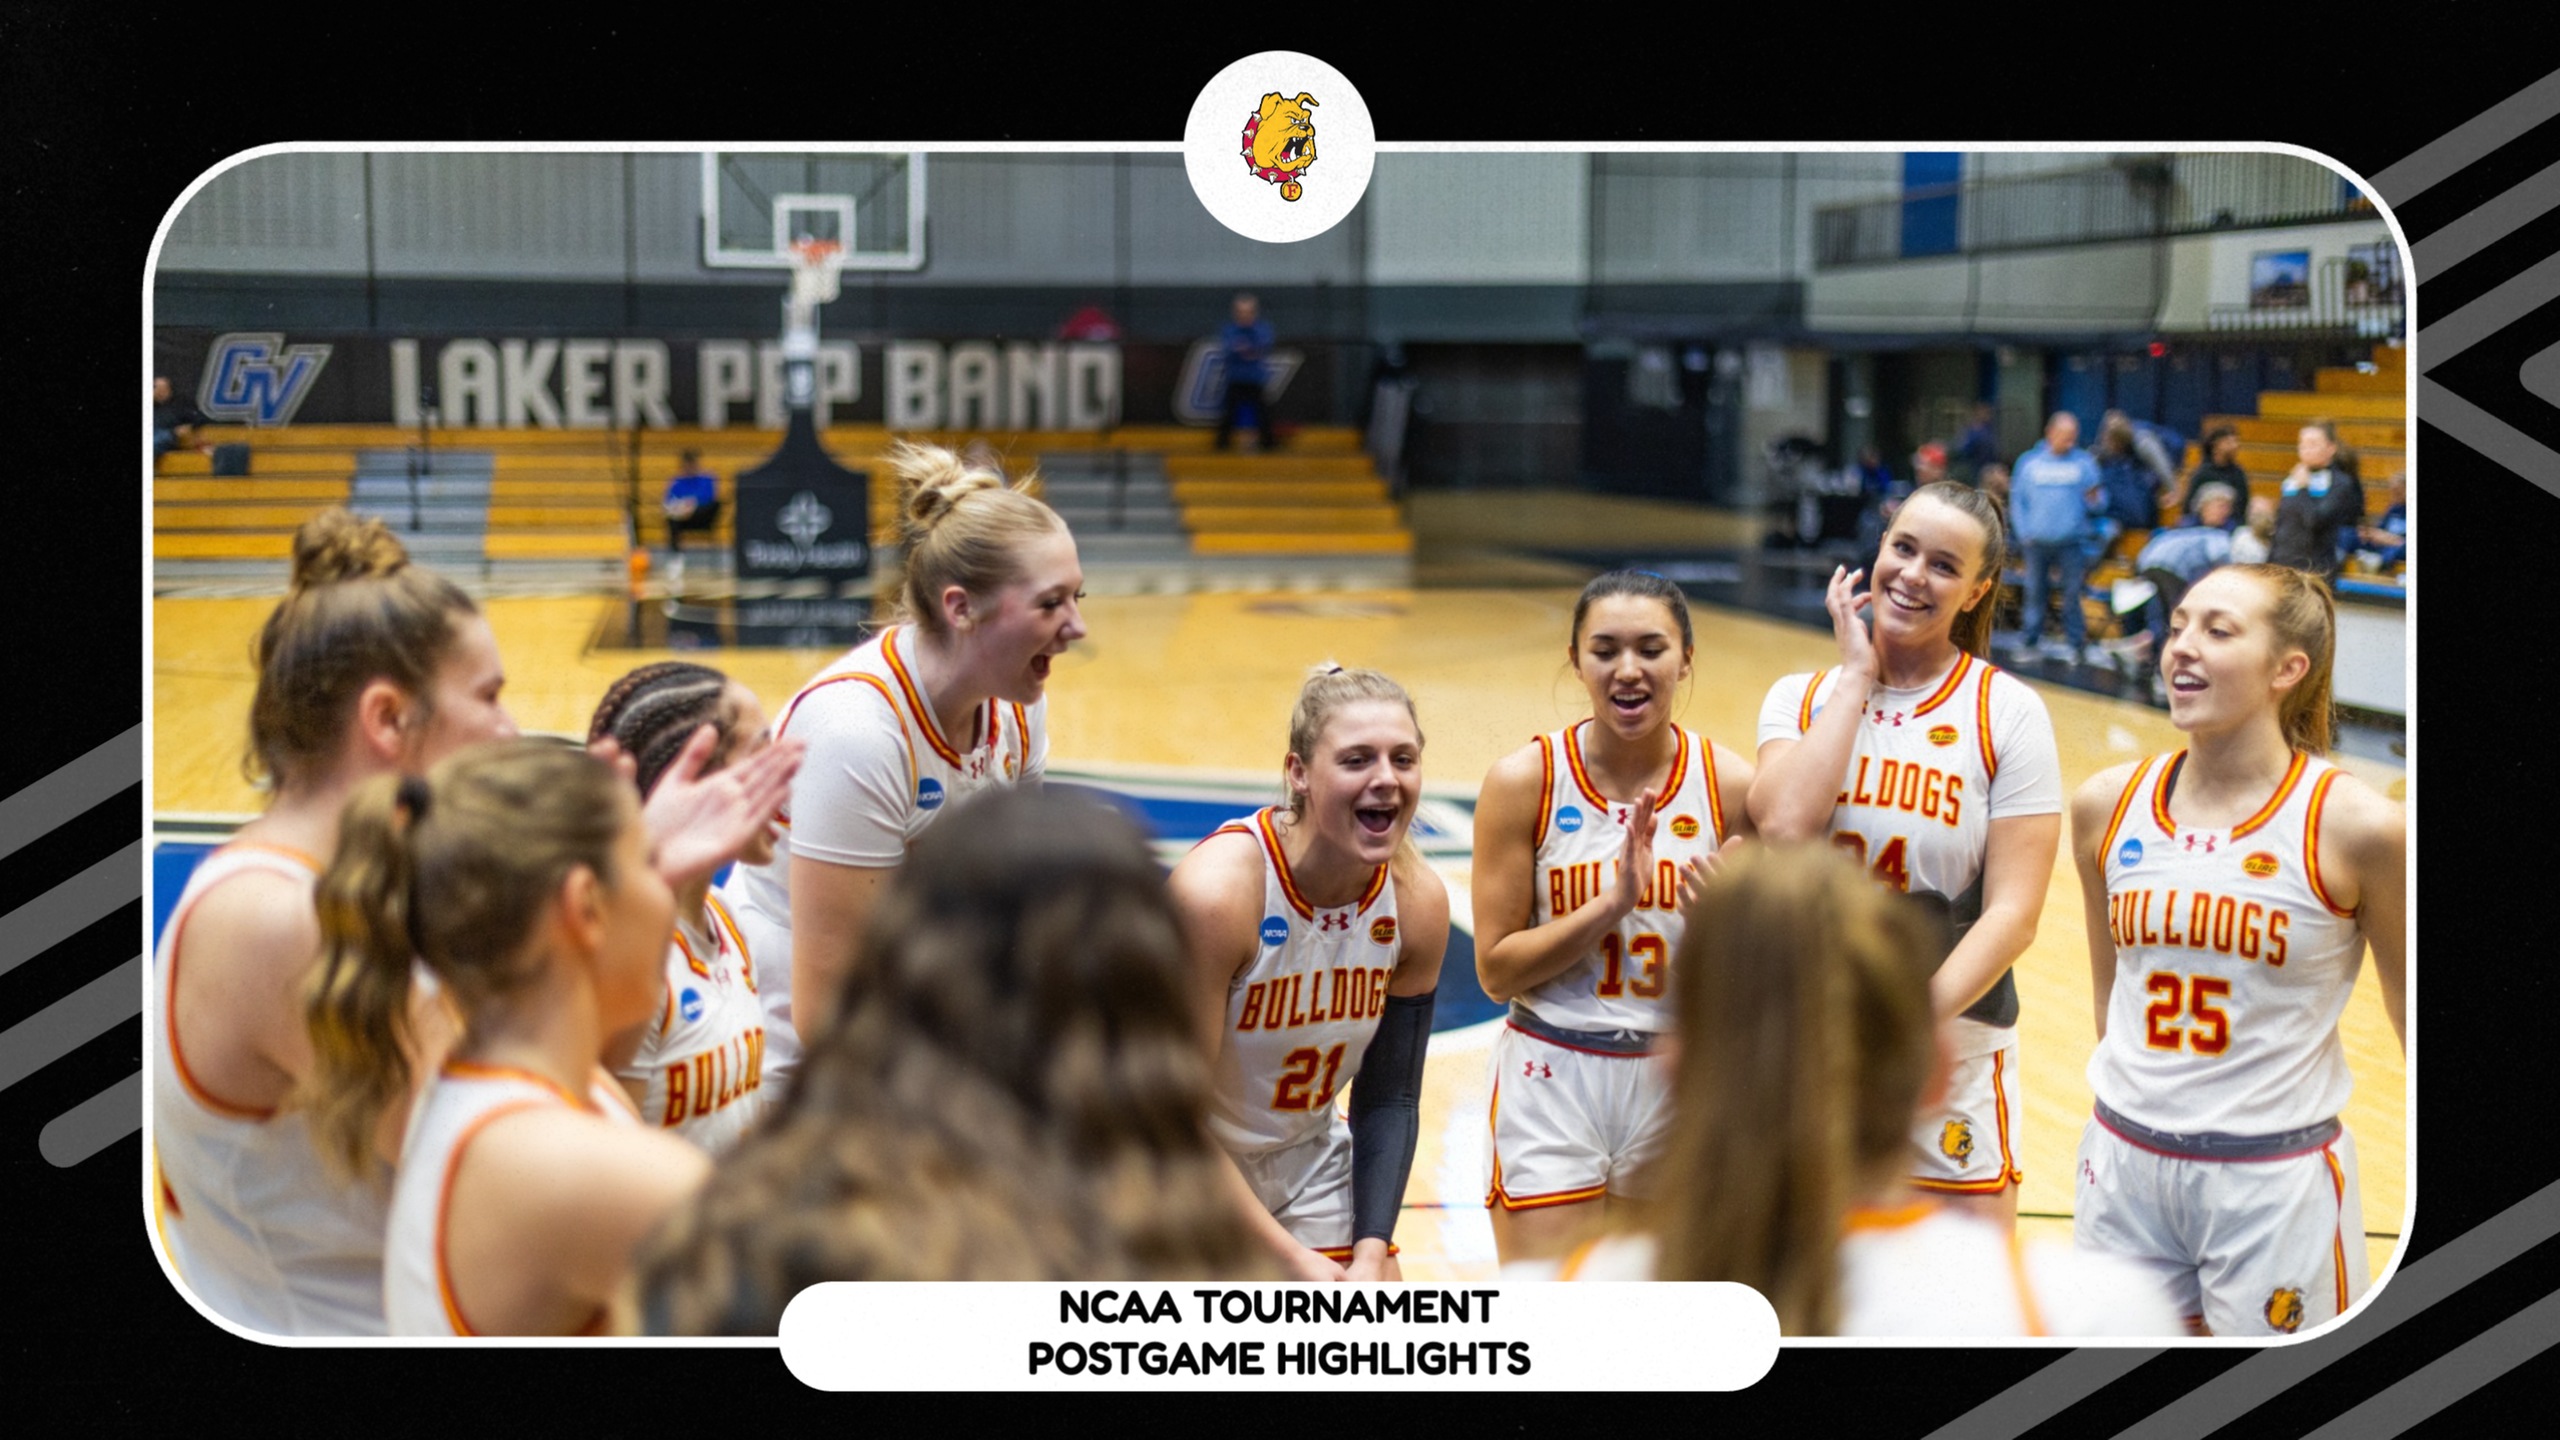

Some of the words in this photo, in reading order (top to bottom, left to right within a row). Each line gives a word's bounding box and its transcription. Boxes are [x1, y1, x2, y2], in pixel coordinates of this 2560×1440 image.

[197, 332, 332, 426] GV
[390, 337, 676, 429] LAKER
[884, 338, 1123, 430] BAND
[1597, 931, 1669, 1000] 13
[2109, 888, 2291, 969] BULLDOGS
[2145, 971, 2231, 1057] 25
[1271, 1042, 1348, 1113] 21
